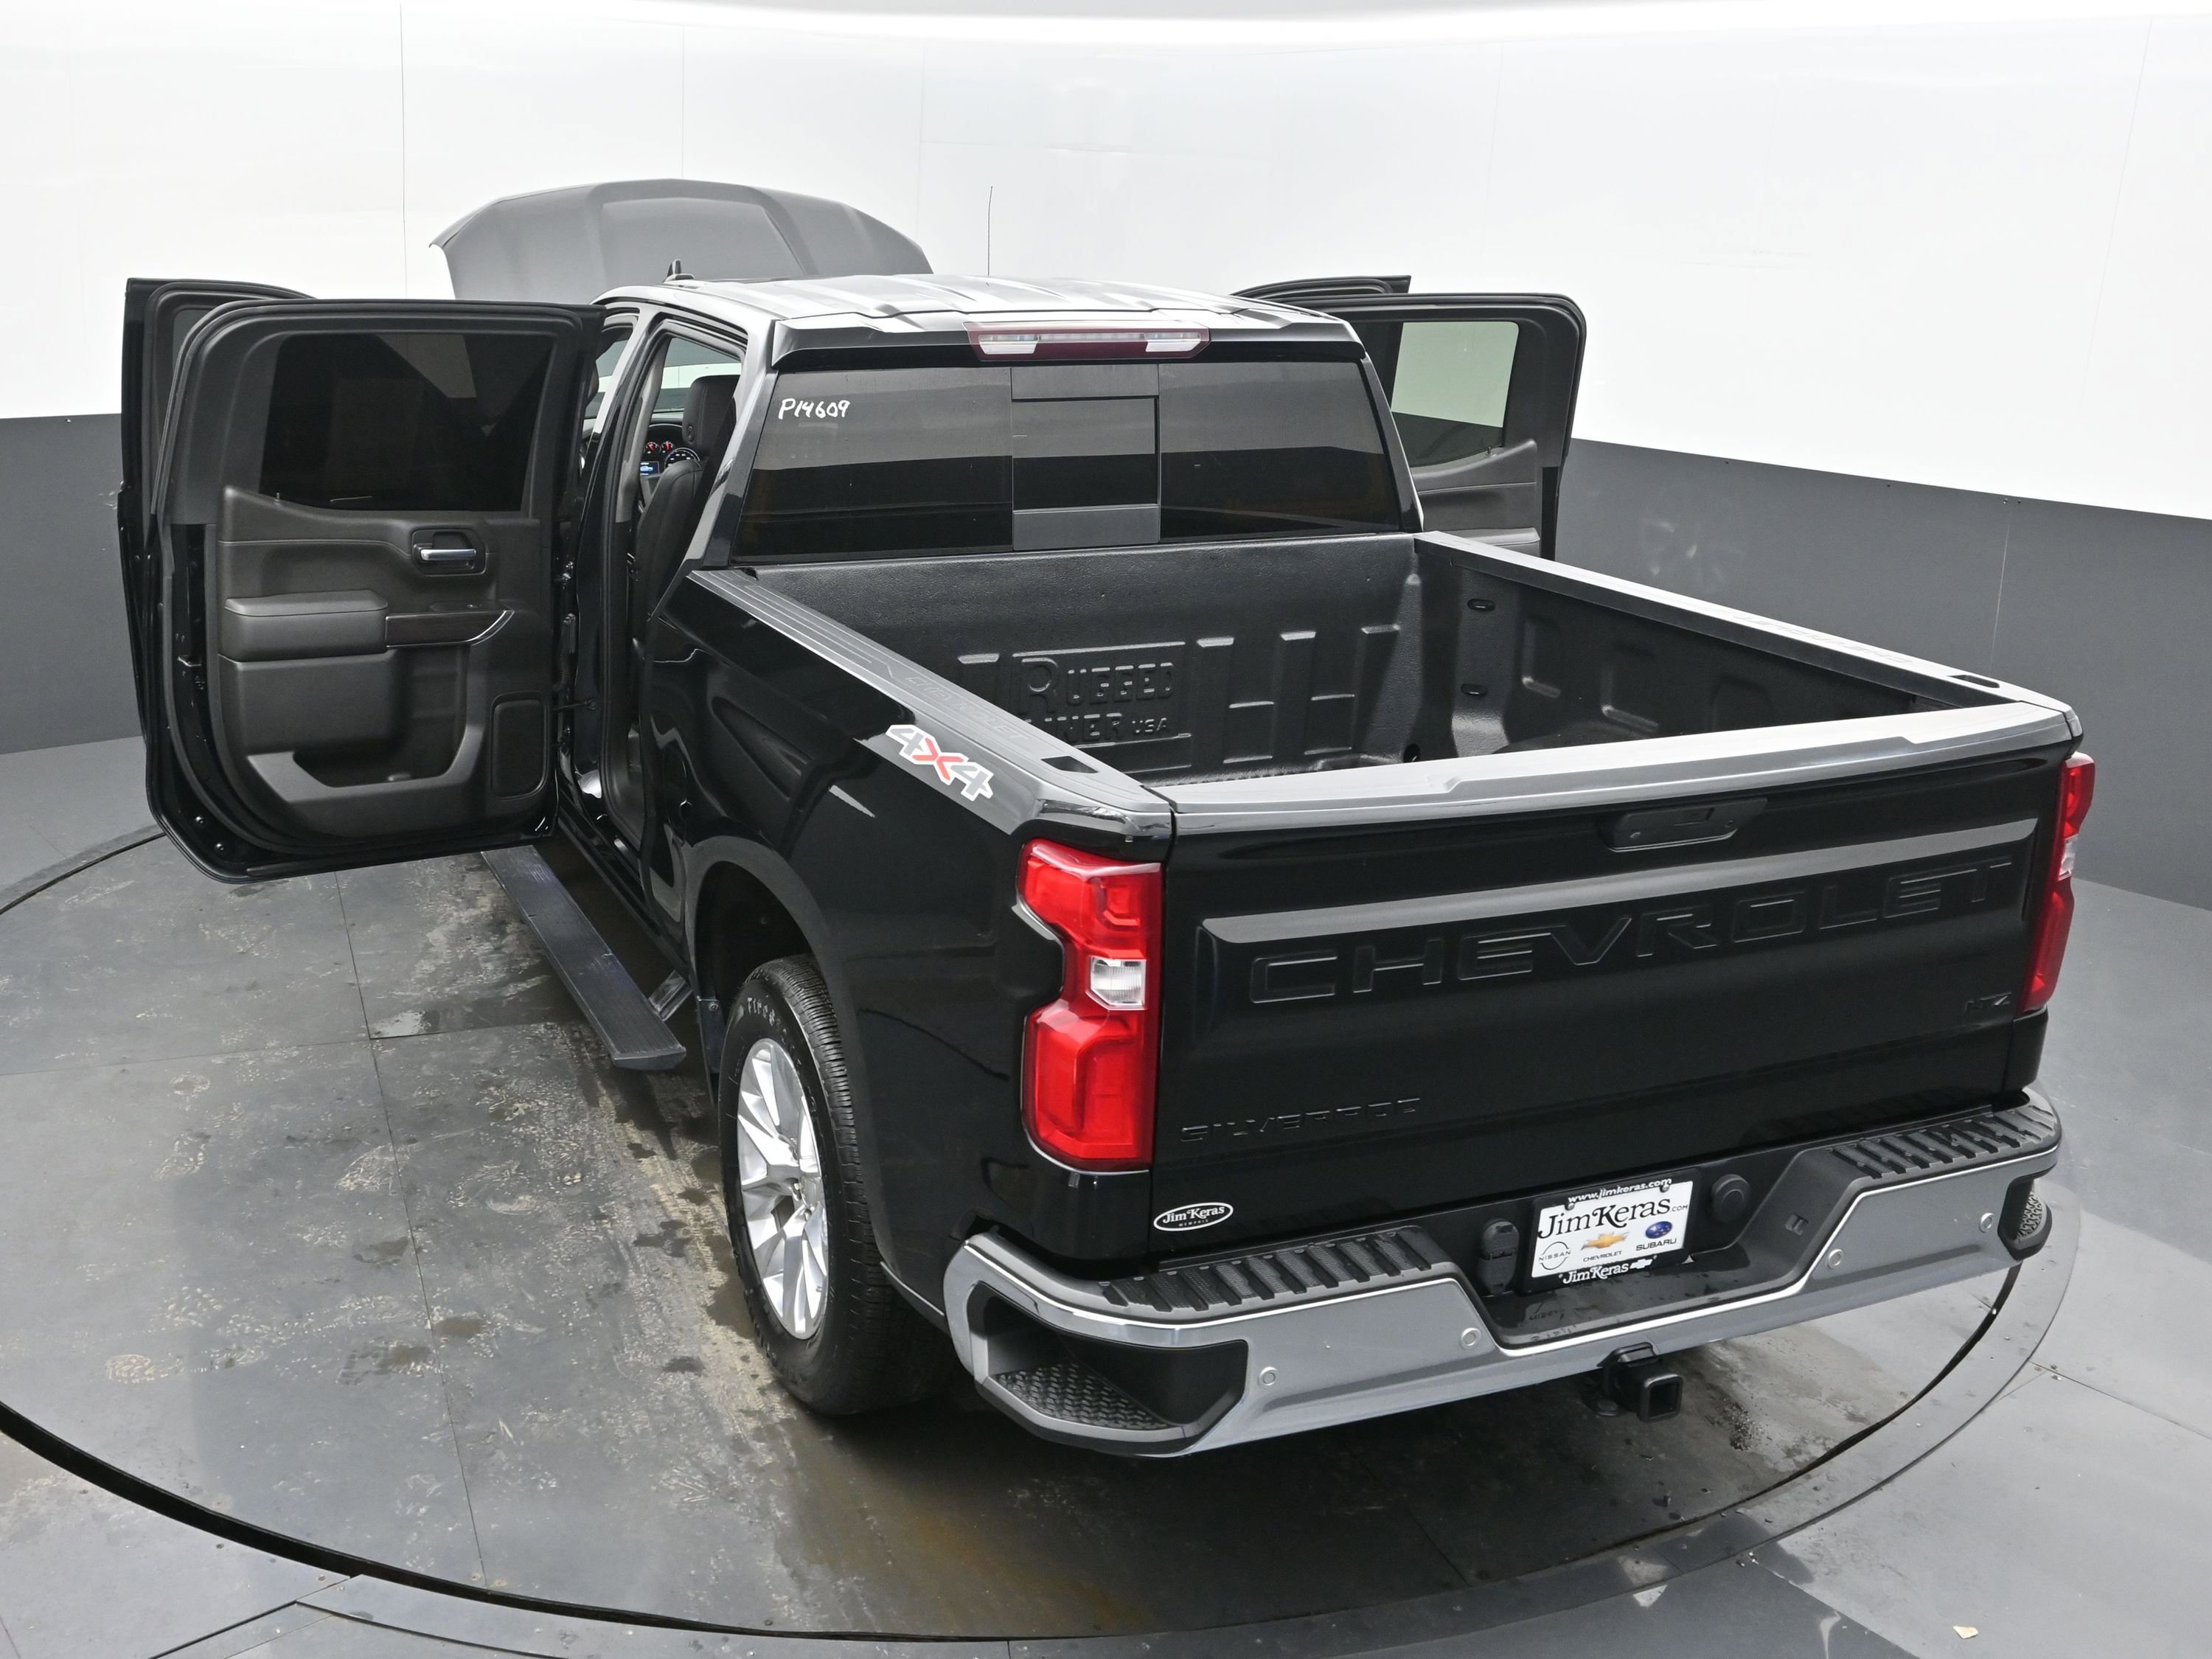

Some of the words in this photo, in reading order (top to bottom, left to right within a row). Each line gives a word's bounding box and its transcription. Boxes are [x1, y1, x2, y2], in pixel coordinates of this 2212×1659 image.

[778, 398, 850, 420] P14609
[1249, 860, 2012, 1004] CHEVROLET
[1180, 1098, 1421, 1143] SILVERADO
[1568, 1178, 1672, 1203] www.jimkeras.com
[1635, 1237, 1677, 1251] SUBARU
[1539, 1250, 1571, 1262] NISSAN
[1582, 1250, 1623, 1263] CHEVROLET
